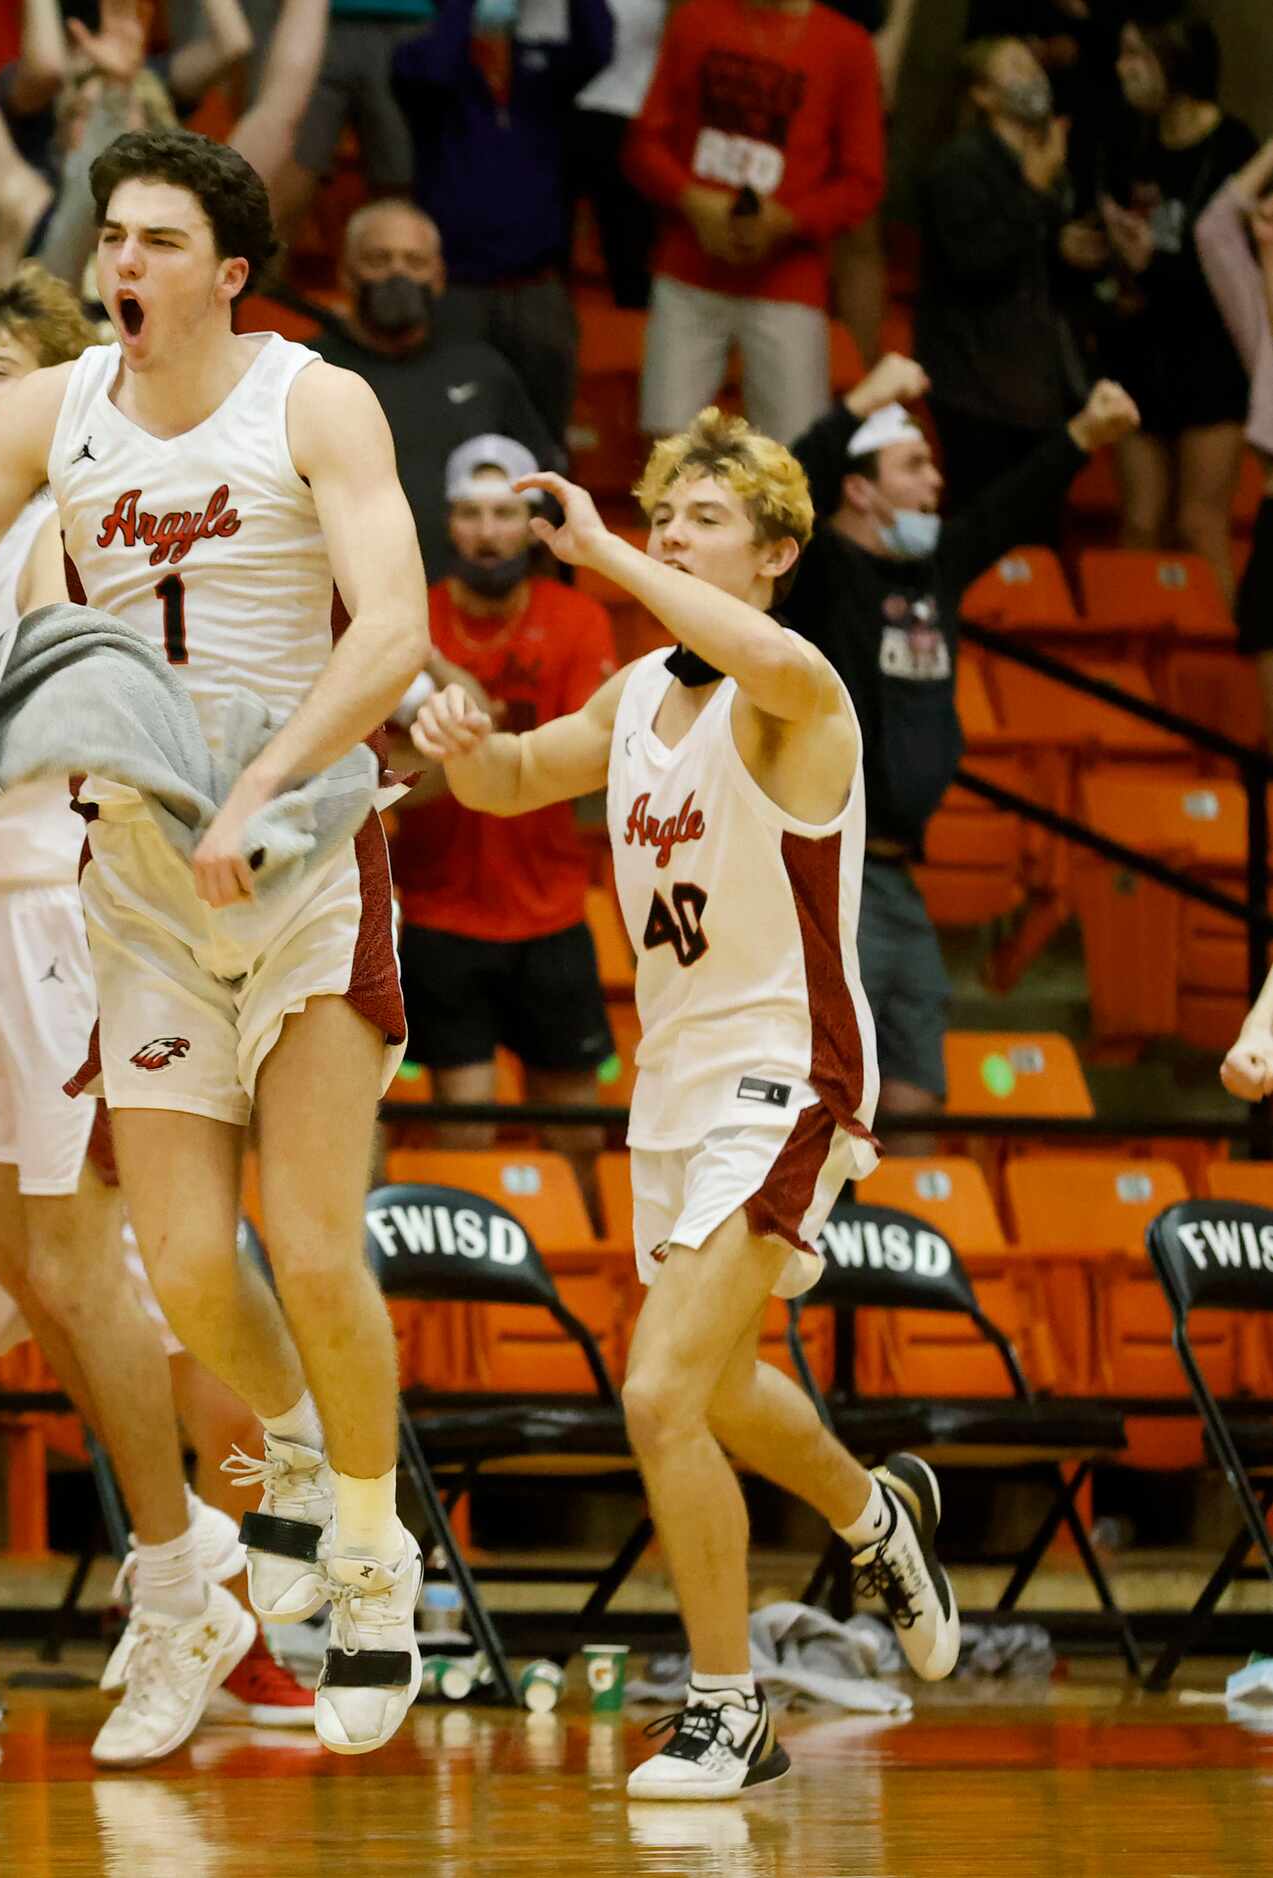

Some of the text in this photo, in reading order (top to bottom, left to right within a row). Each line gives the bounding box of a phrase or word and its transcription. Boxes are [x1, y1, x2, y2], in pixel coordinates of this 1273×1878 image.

[691, 127, 785, 195] RED
[97, 484, 242, 566] Argyle
[154, 573, 189, 665] 1
[643, 882, 710, 967] 40
[365, 1204, 527, 1265] FWISD
[817, 1220, 952, 1278] WISD
